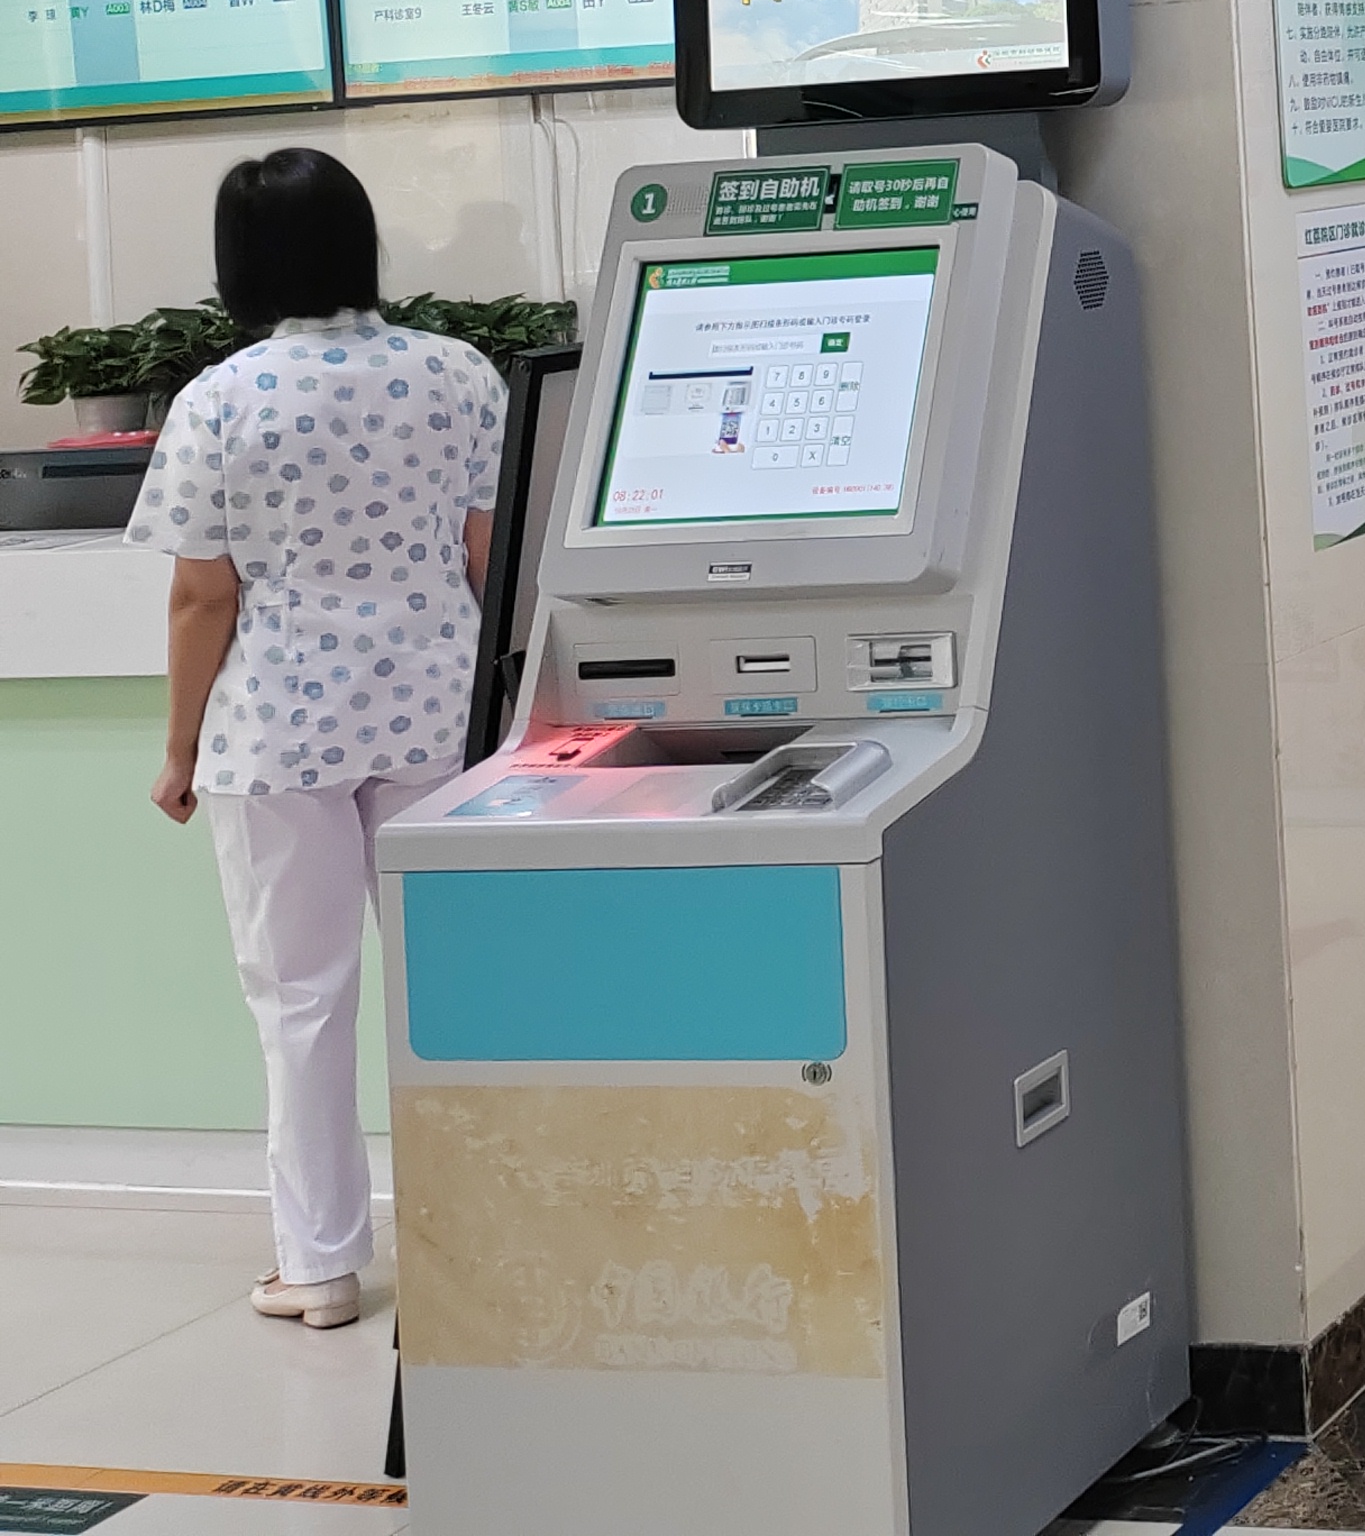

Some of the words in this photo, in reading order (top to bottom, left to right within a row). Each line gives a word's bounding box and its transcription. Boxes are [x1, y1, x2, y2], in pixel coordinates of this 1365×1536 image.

[373, 7, 422, 21] 产科诊室9
[717, 176, 821, 202] 签到自助机
[848, 176, 949, 195] 请取号30秒后再自
[611, 488, 664, 503] 08:22:01
